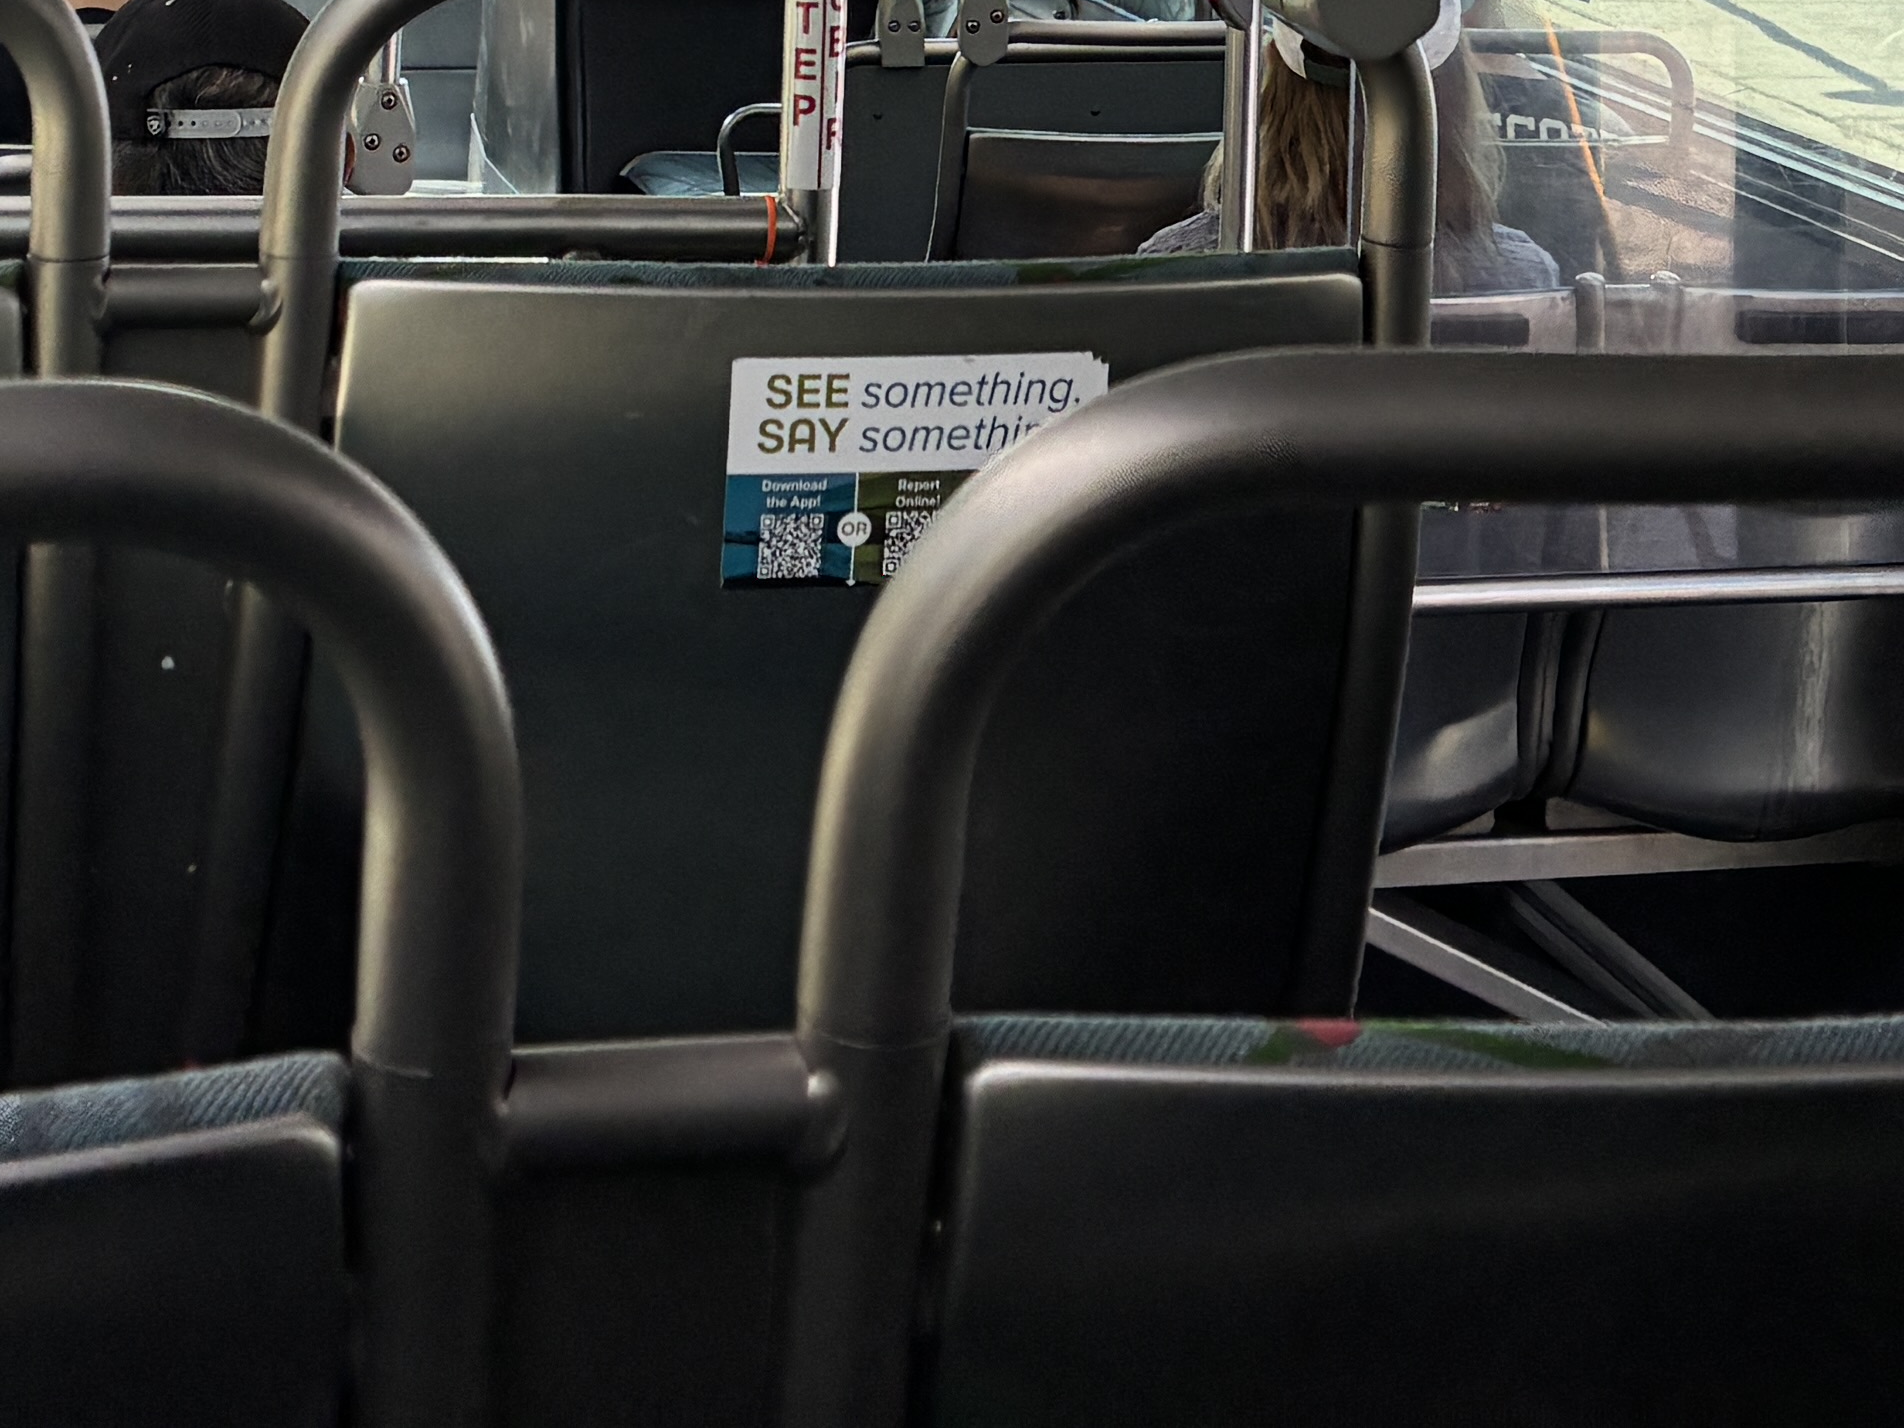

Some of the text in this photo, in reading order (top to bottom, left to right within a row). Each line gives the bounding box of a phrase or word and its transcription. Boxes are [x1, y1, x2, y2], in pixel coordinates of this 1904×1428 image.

[792, 1, 819, 126] TEP
[765, 371, 1081, 414] SEE something.
[757, 415, 1042, 455] SAY somethi
[761, 478, 828, 492] Download
[898, 478, 940, 493] Report
[766, 495, 822, 510] the App!
[895, 494, 941, 509] Online!
[841, 521, 867, 537] OR
